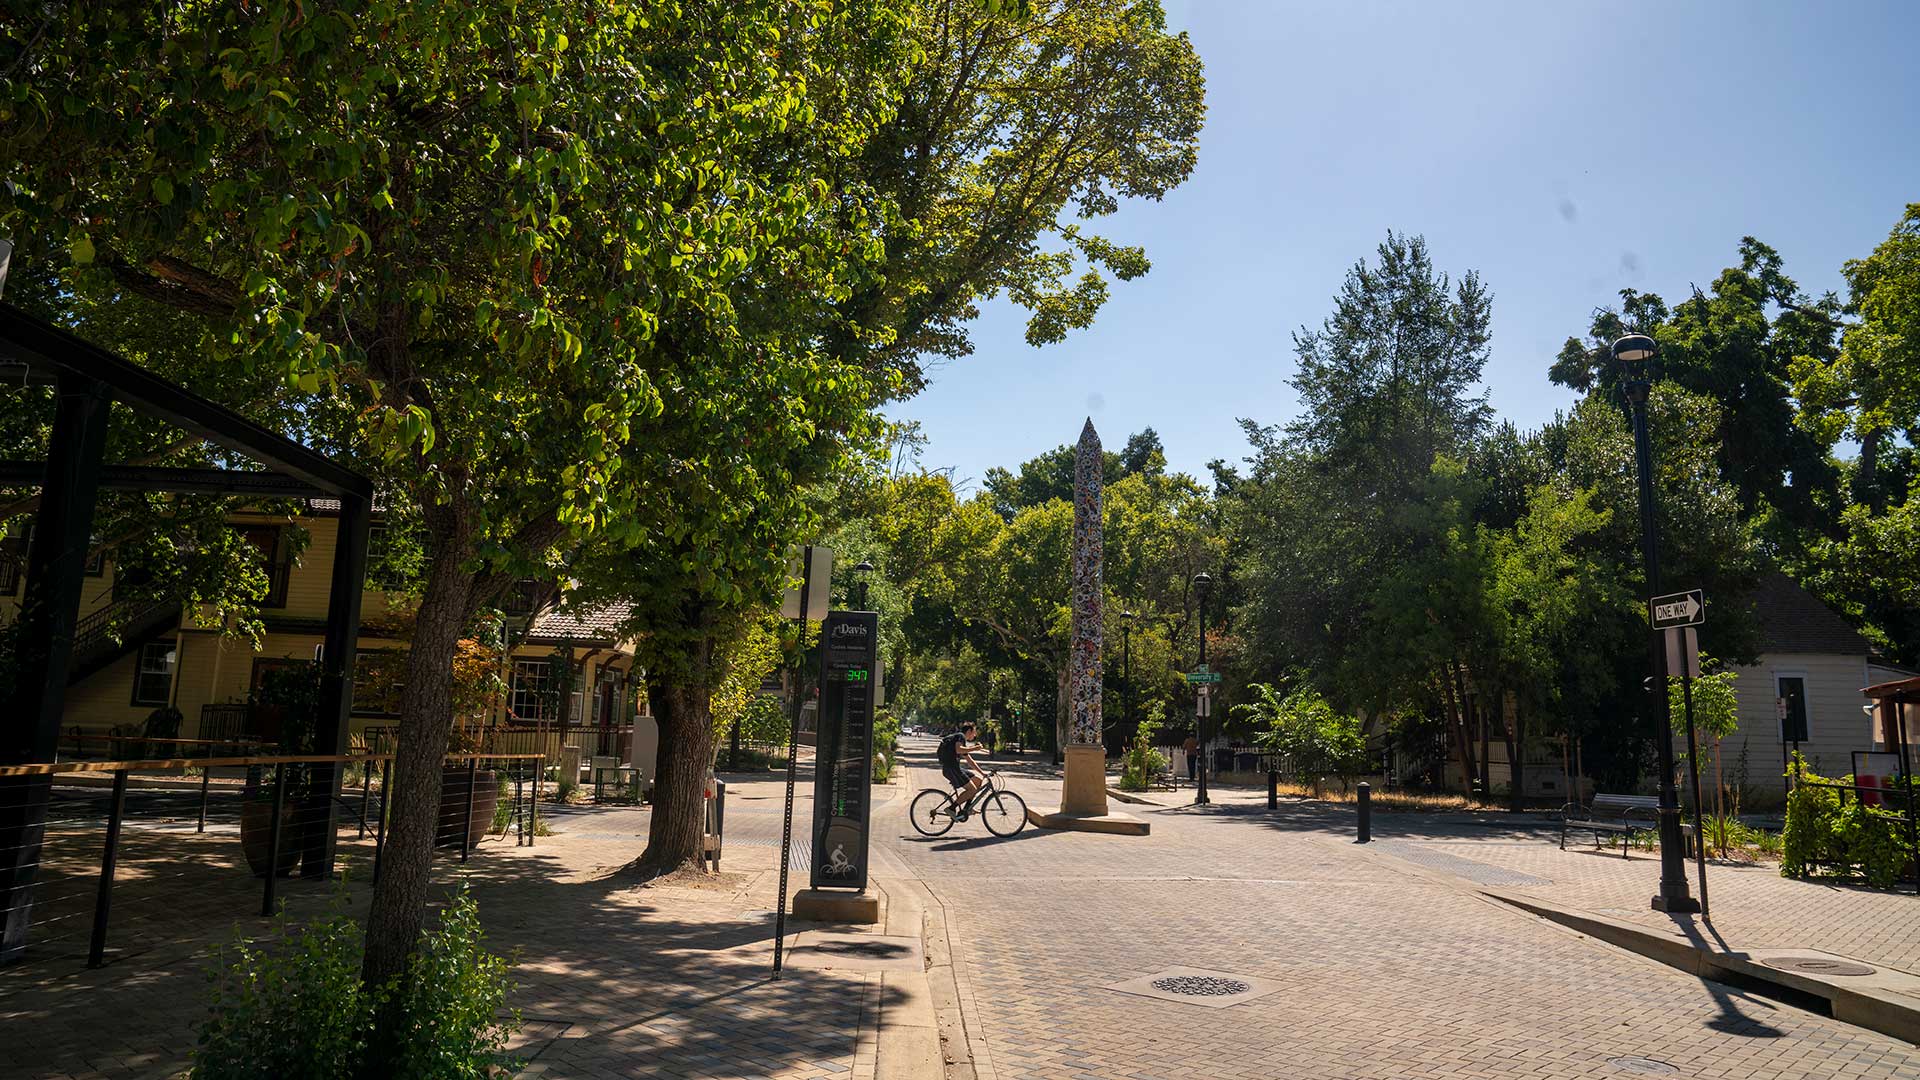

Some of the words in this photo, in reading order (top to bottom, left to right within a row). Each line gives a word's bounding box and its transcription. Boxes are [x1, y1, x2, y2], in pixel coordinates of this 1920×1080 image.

[1657, 606, 1672, 619] ONE
[1672, 602, 1688, 617] WAY
[841, 623, 868, 635] Davis
[847, 670, 868, 681] 347
